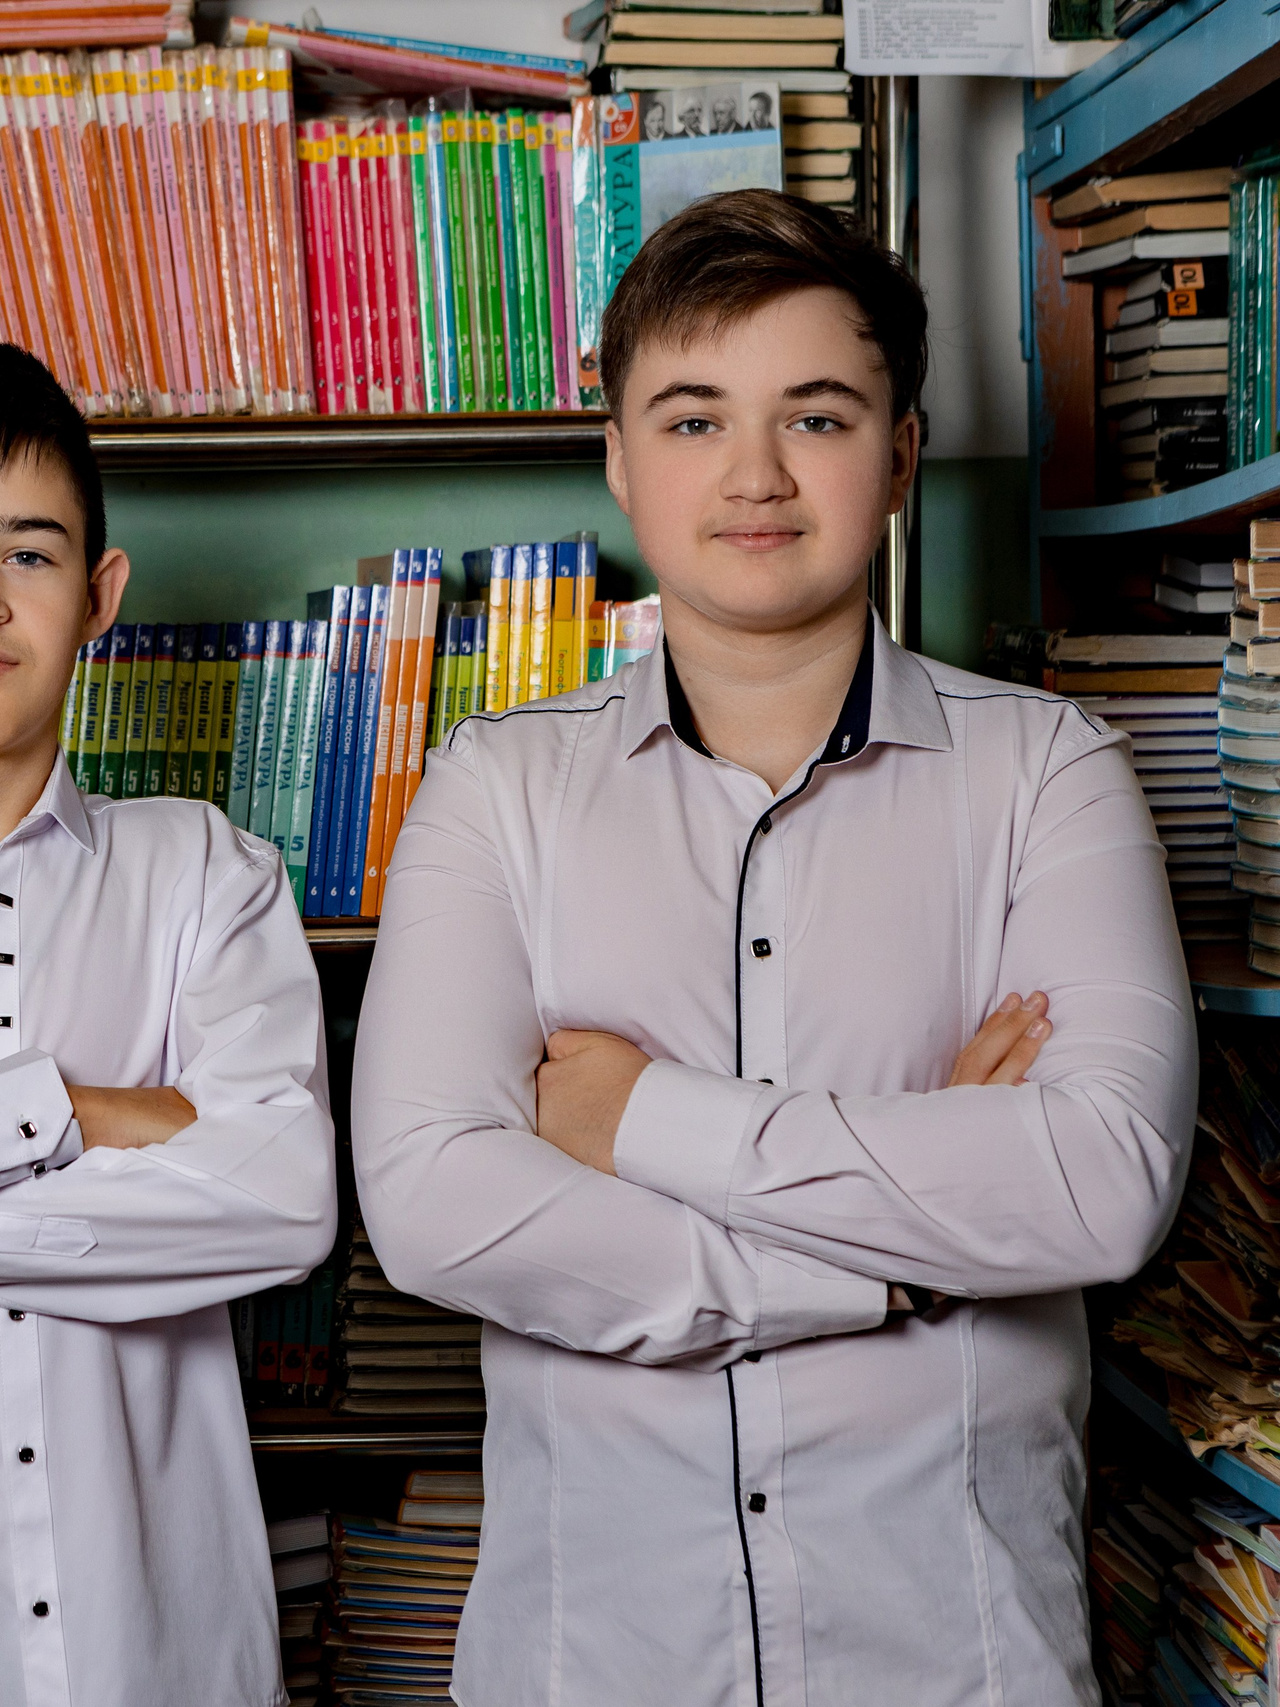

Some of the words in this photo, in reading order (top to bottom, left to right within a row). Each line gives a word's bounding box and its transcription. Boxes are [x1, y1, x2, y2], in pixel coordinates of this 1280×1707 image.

[1181, 268, 1197, 284] 10
[1174, 293, 1190, 310] 10
[580, 353, 596, 373] 6
[332, 632, 341, 670] ИСТОРИЯ
[352, 633, 361, 671] ИСТОРИЯ
[371, 633, 380, 671] ИСТОРИЯ
[87, 682, 101, 716] Русский
[111, 681, 125, 715] Русский
[134, 680, 148, 715] Русский
[157, 680, 172, 714] Русский
[199, 680, 212, 715] Русский
[222, 680, 235, 715] Русский
[327, 677, 337, 715] ИСТОРИЯ
[347, 677, 357, 716] ИСТОРИЯ
[366, 677, 376, 716] ИСТОРИЯ
[85, 720, 96, 741] язык
[109, 719, 120, 740] язык
[132, 718, 143, 739] язык
[155, 718, 166, 739] язык
[197, 718, 208, 739] язык
[220, 718, 231, 739] язык
[233, 671, 255, 792] ЛИТЕРАТУРА
[324, 718, 333, 754] РОССИИ
[344, 719, 353, 754] РОССИИ
[363, 719, 372, 754] РОССИИ
[80, 772, 91, 794] 5
[104, 771, 114, 793] 5
[128, 770, 137, 792] 5
[150, 770, 160, 791] 5
[193, 770, 202, 792] 5
[217, 770, 225, 792] 5
[273, 836, 286, 851] 5
[291, 836, 305, 851] 5
[368, 865, 377, 877] 6
[311, 886, 317, 896] 6
[330, 886, 337, 897] 6
[350, 886, 356, 896] 6
